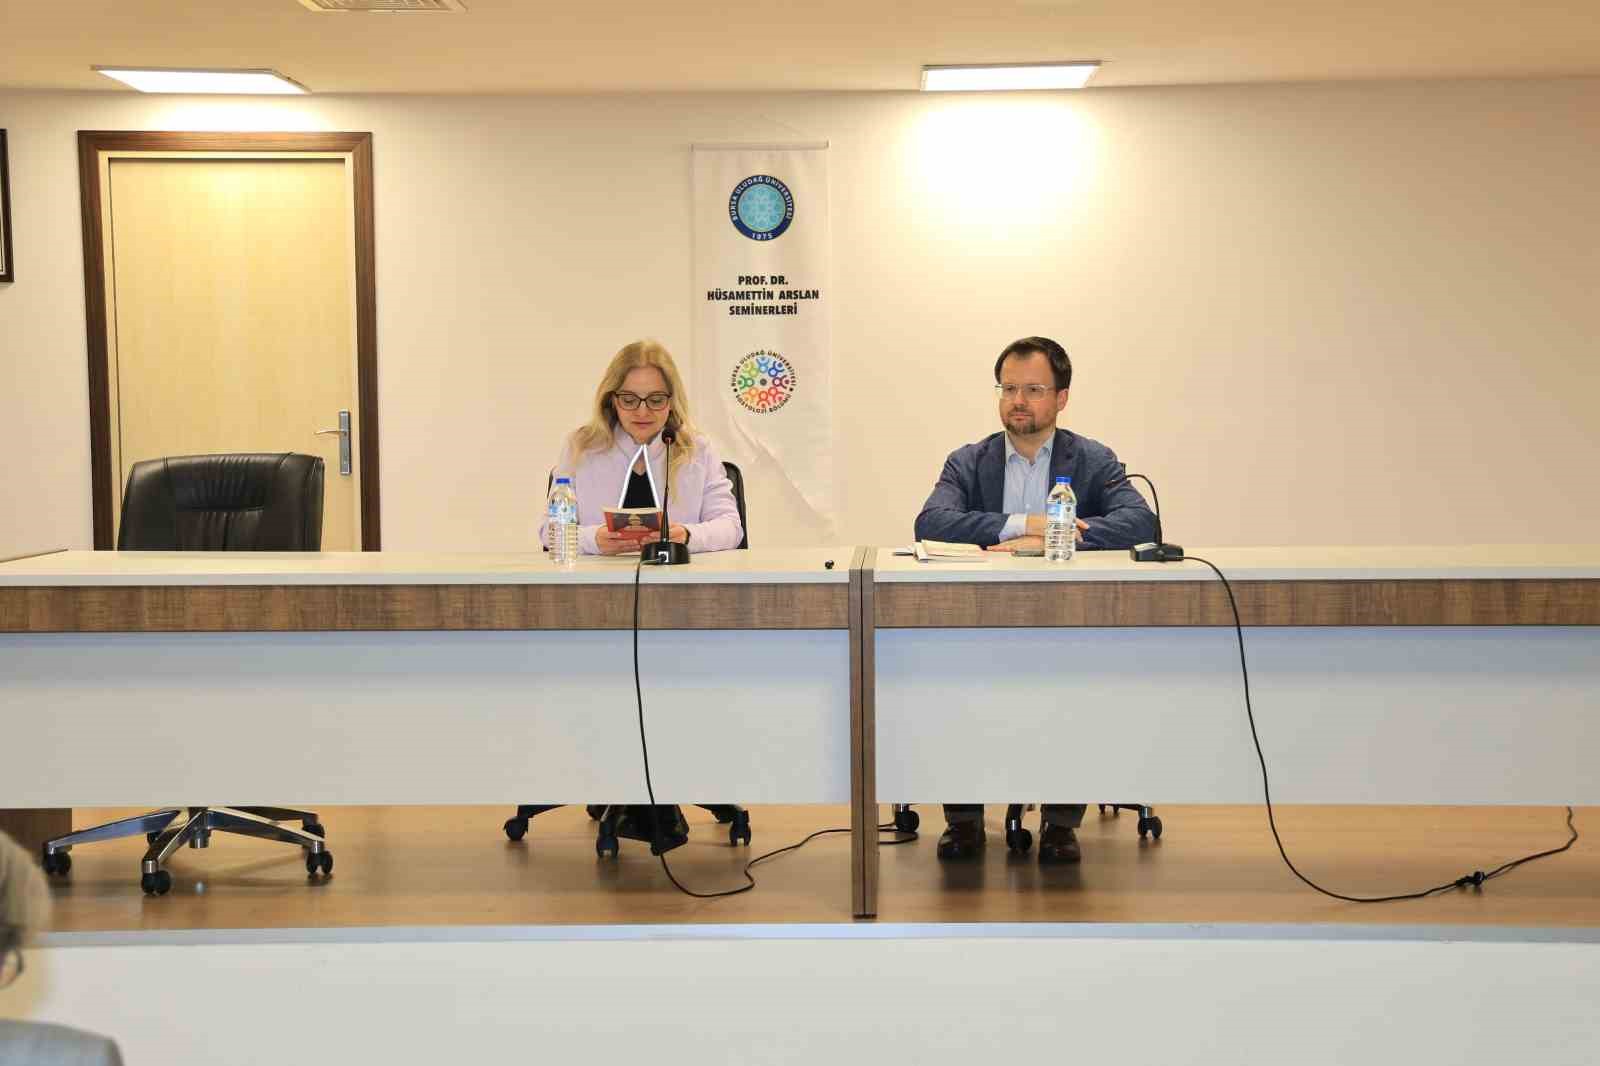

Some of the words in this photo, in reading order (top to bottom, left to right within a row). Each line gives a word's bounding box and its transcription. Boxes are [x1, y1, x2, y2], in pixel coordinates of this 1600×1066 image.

[738, 275, 768, 285] PROF.
[770, 275, 789, 285] DR.
[707, 288, 774, 301] HÜSAMETTİN
[778, 289, 820, 300] ARSLAN
[729, 302, 798, 316] SEMİNERLERİ
